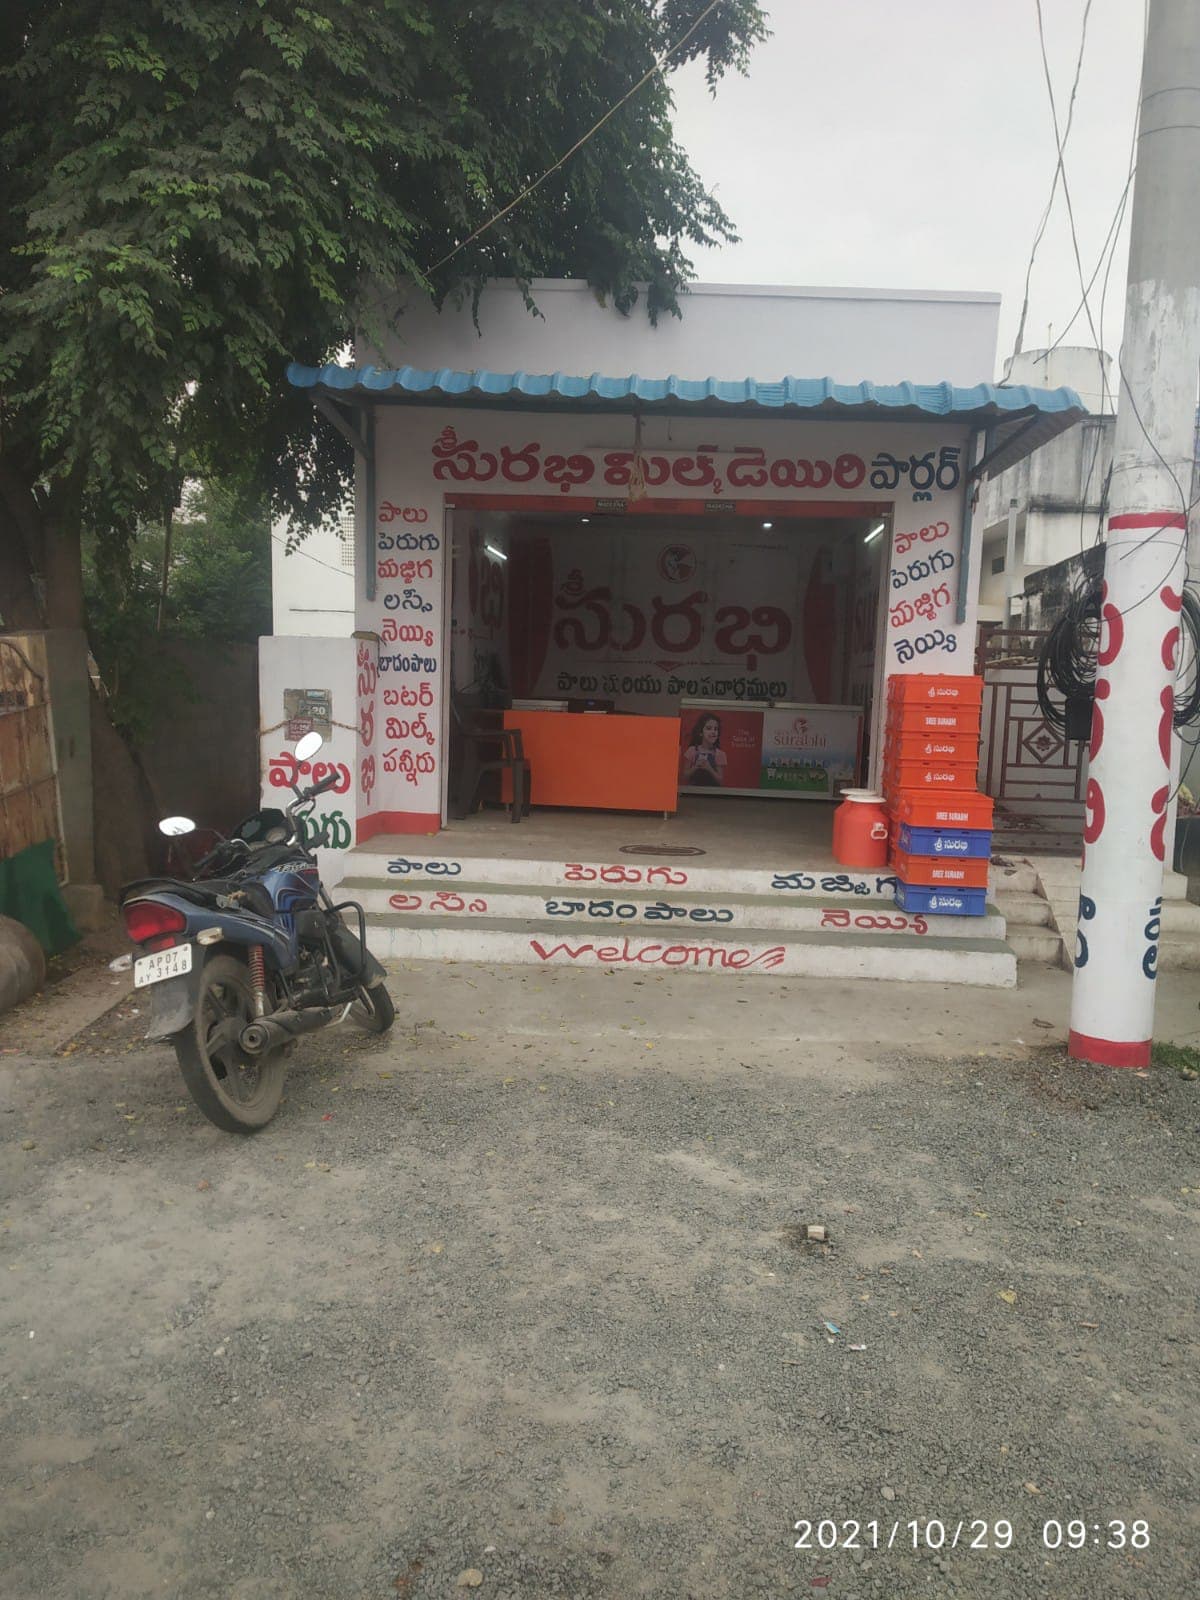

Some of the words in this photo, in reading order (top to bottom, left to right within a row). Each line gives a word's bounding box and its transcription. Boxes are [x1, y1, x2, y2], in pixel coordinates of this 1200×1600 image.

[432, 439, 595, 493] సురభి
[870, 446, 961, 502] పార్లర్
[378, 501, 428, 523] పాలు
[378, 532, 440, 551] పెరుగు
[894, 521, 950, 554] పాలు
[377, 558, 433, 584] మజ్జిగ
[890, 549, 955, 589] పెరుగు
[383, 588, 433, 613] లస్సి
[889, 582, 952, 629] మజ్జిగ
[381, 618, 434, 647] నెయ్యి
[553, 585, 792, 671] సురభి
[893, 629, 958, 664] నెయ్యి
[380, 653, 437, 673] బాదంపాలు
[557, 671, 598, 691] పాలు
[383, 682, 434, 707] బటర్
[385, 712, 436, 745] మిల్క్
[269, 751, 352, 794] పాలు
[382, 747, 436, 787] పన్నీరు
[387, 858, 462, 876] పాలు
[564, 863, 688, 886] పెరుగు
[771, 872, 897, 895] మజ్జిగ
[156, 960, 187, 978] 3148
